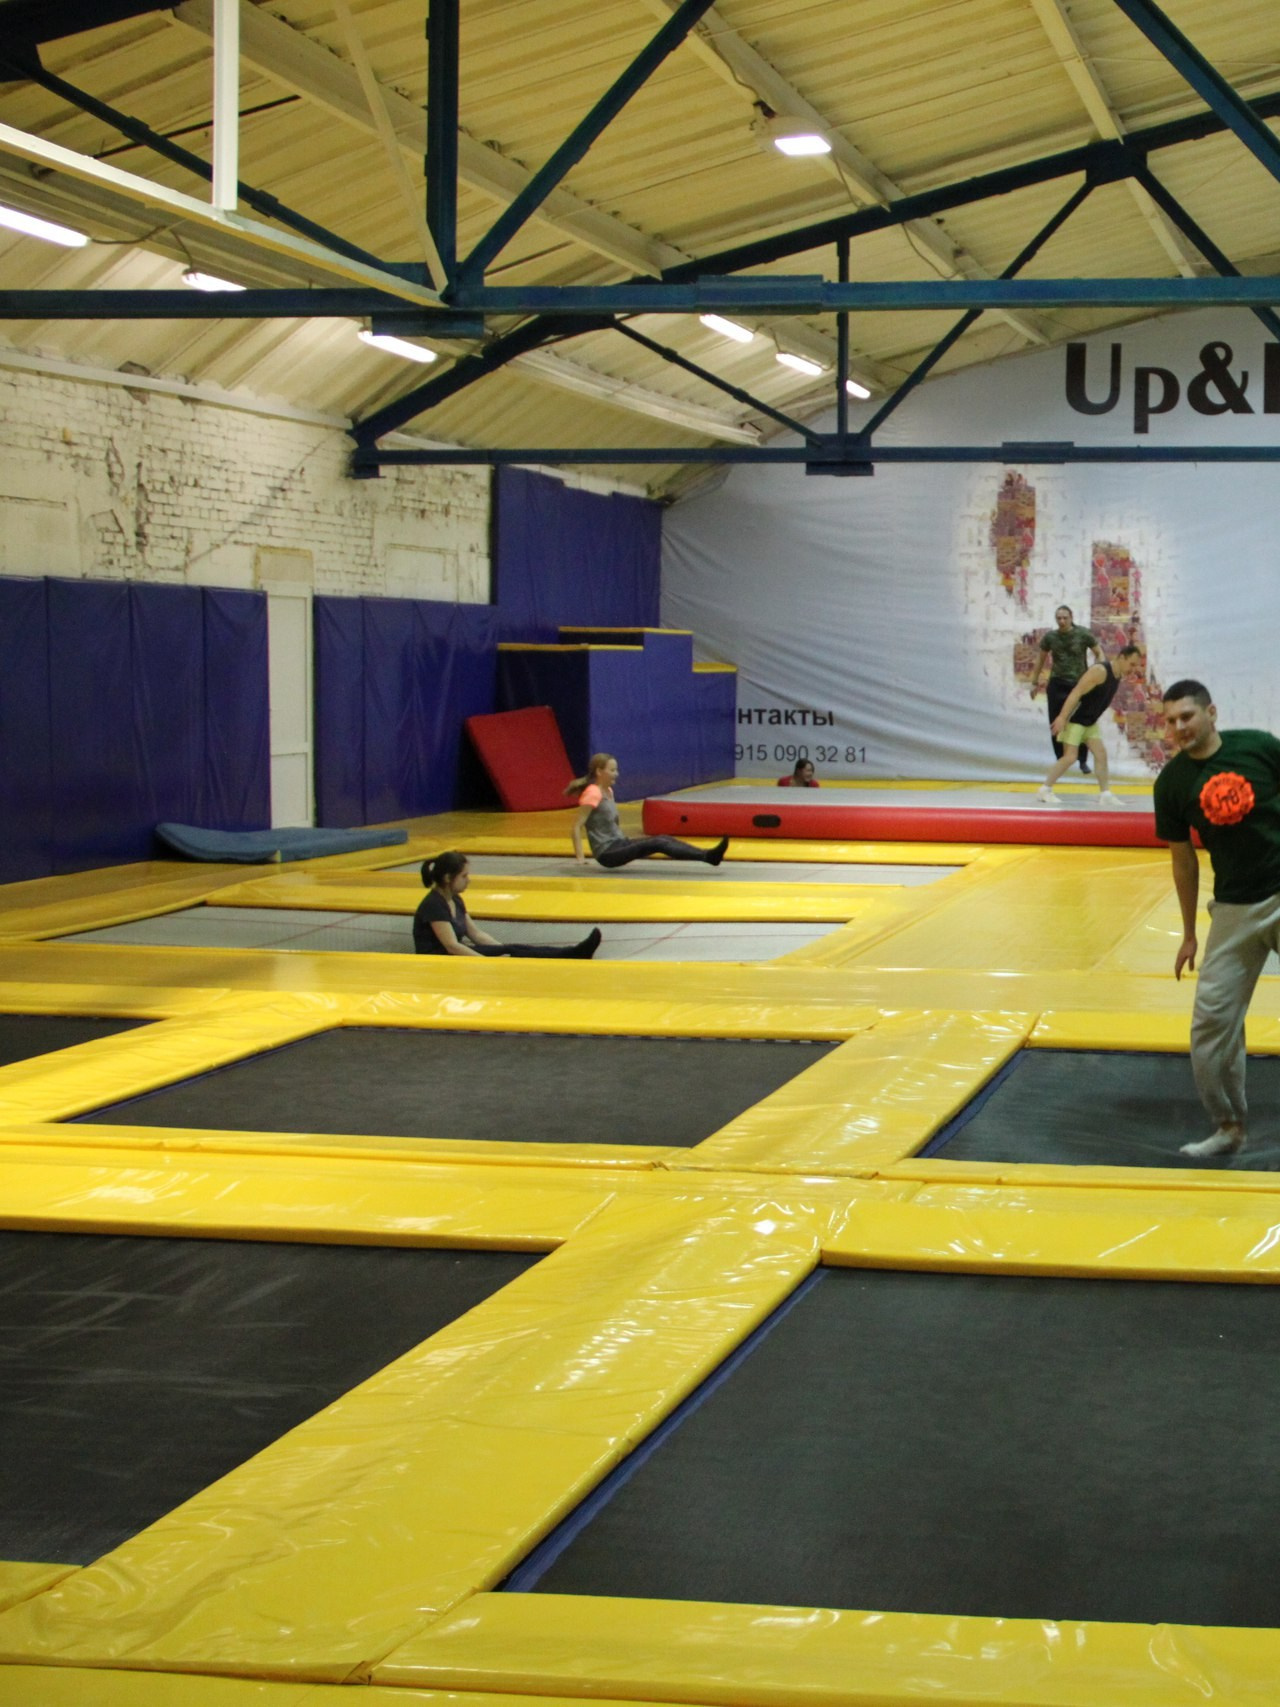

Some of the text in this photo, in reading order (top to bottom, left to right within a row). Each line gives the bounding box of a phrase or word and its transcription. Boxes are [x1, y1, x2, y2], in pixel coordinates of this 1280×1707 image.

[735, 744, 866, 763] 915 090 32 81
